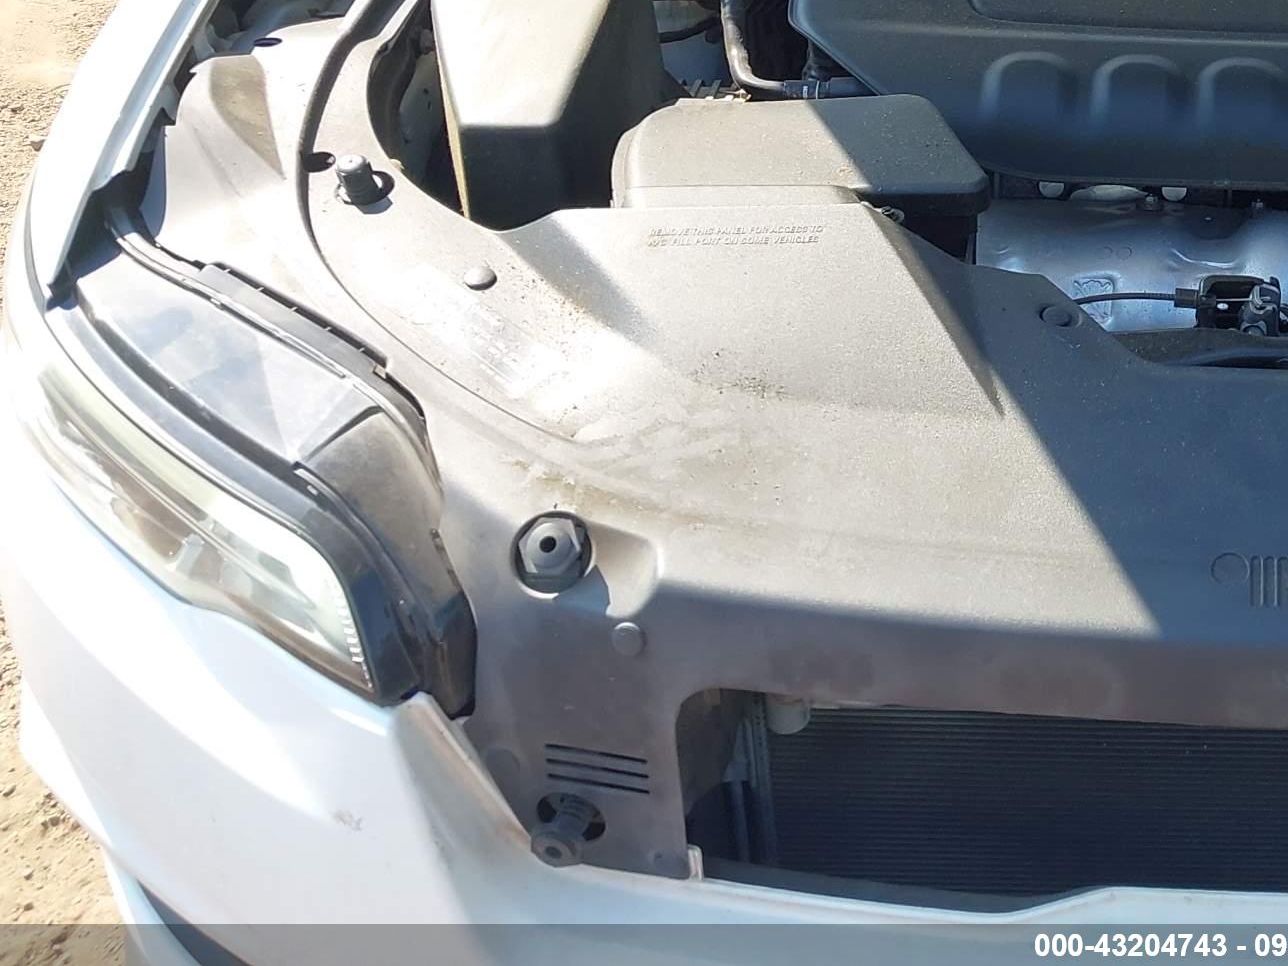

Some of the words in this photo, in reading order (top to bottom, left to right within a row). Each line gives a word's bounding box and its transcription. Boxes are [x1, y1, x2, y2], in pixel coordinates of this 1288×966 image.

[716, 226, 746, 235] PANEL
[749, 226, 769, 234] FOR
[769, 225, 809, 234] ACCESS
[810, 225, 824, 233] TO
[671, 238, 692, 246] FILL
[695, 237, 721, 246] PORT
[723, 237, 739, 245] ON
[740, 236, 770, 245] SOME
[773, 235, 820, 244] VEHICLES
